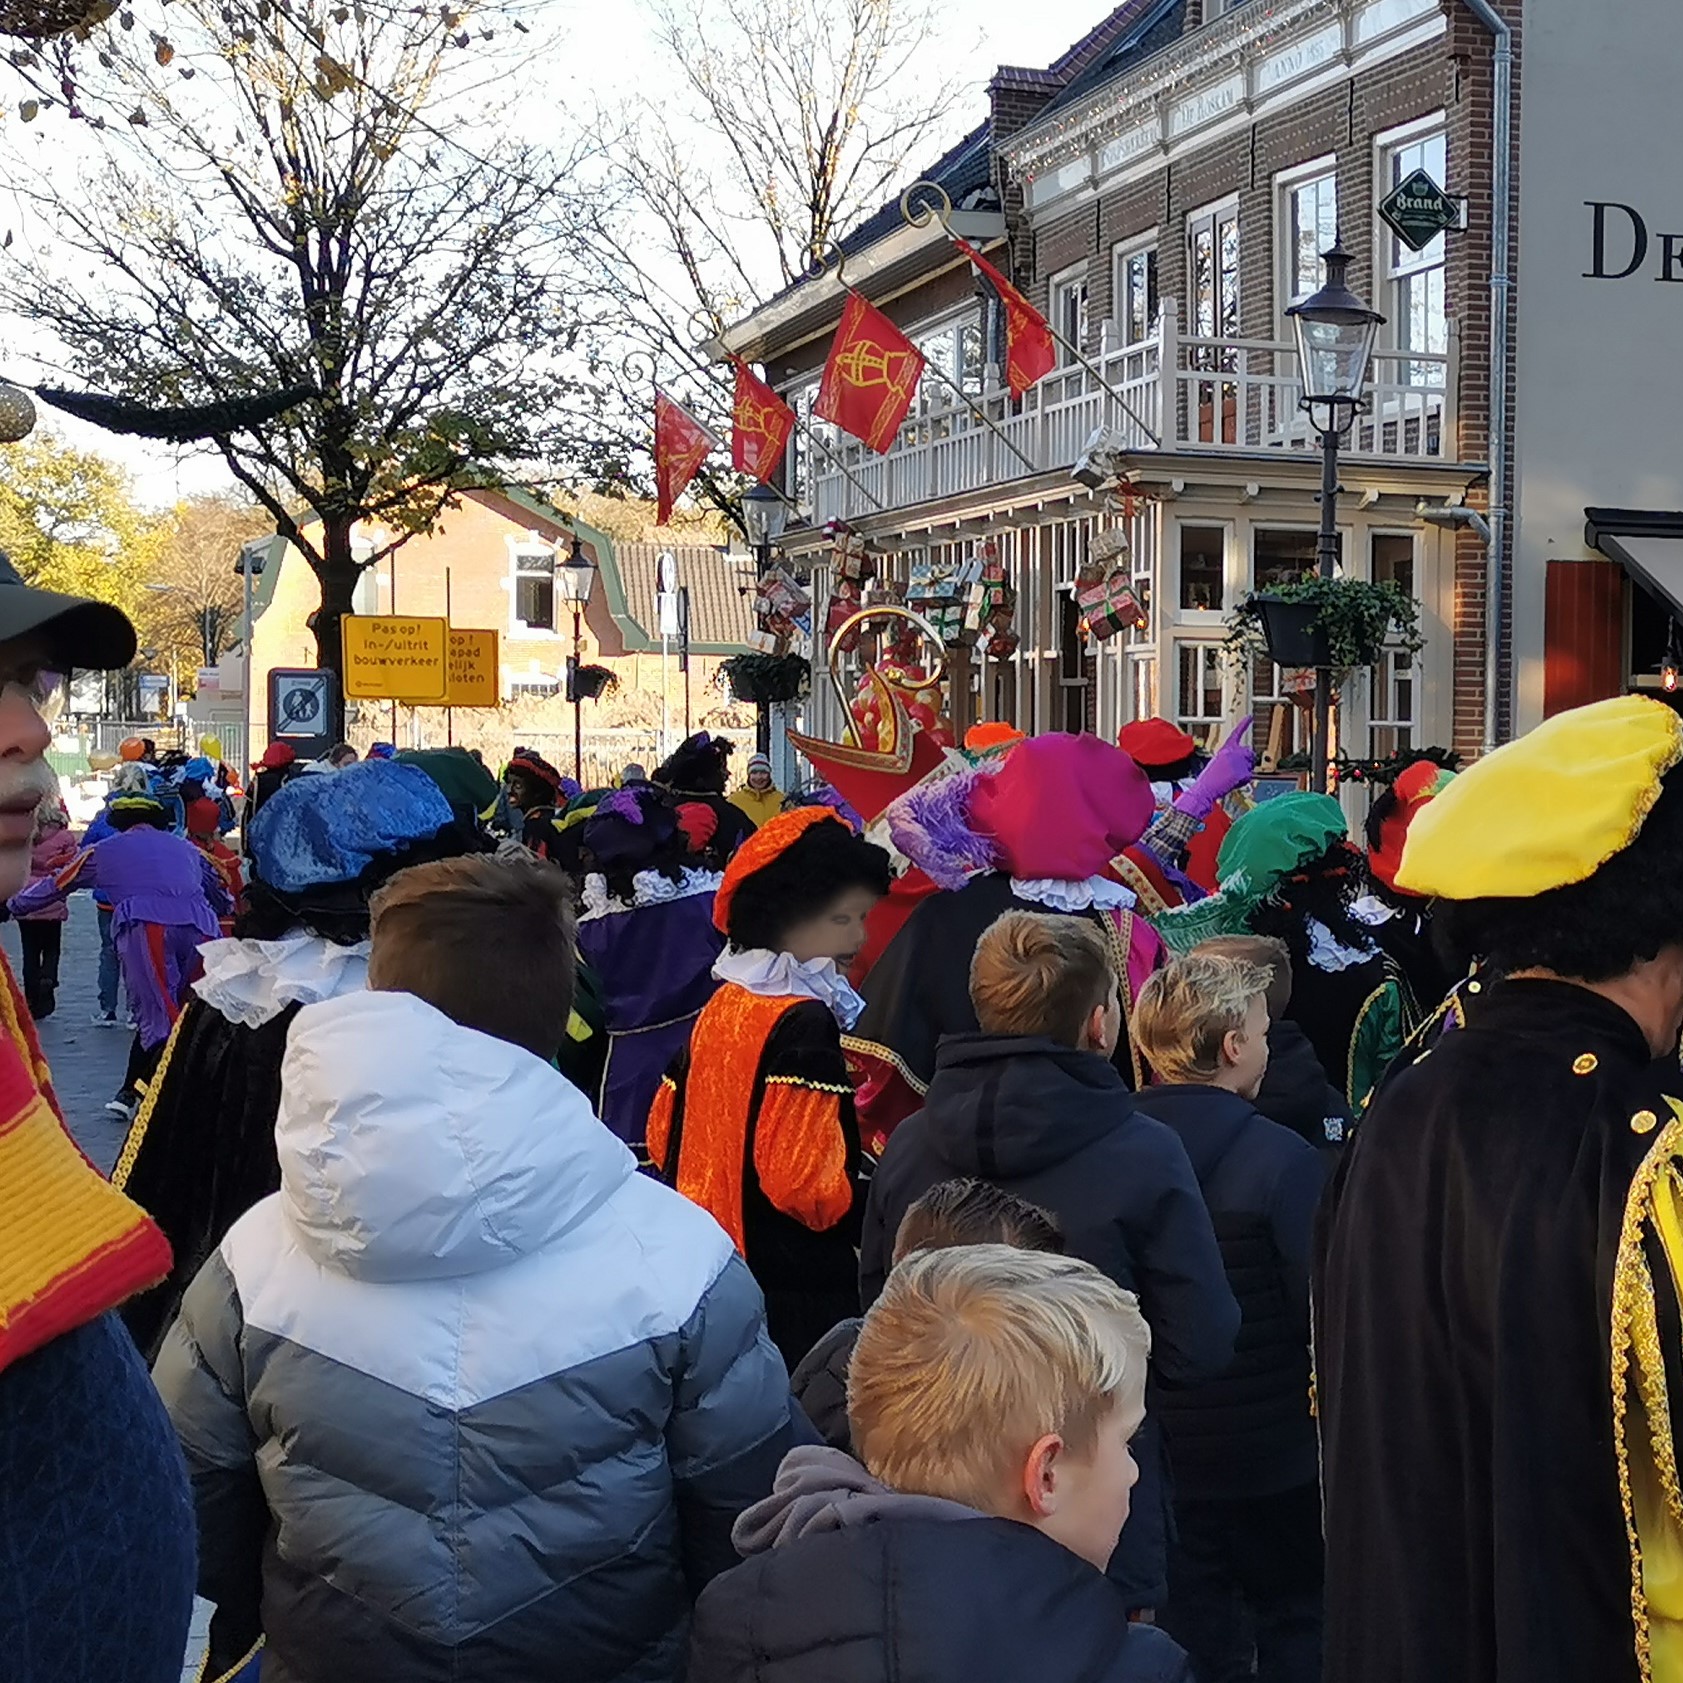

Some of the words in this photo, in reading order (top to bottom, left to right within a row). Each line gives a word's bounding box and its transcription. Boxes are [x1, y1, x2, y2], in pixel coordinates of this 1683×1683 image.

[1396, 191, 1443, 211] Brand
[372, 622, 397, 635] Pas
[400, 623, 421, 636] op!
[353, 653, 440, 667] bouwverkeer
